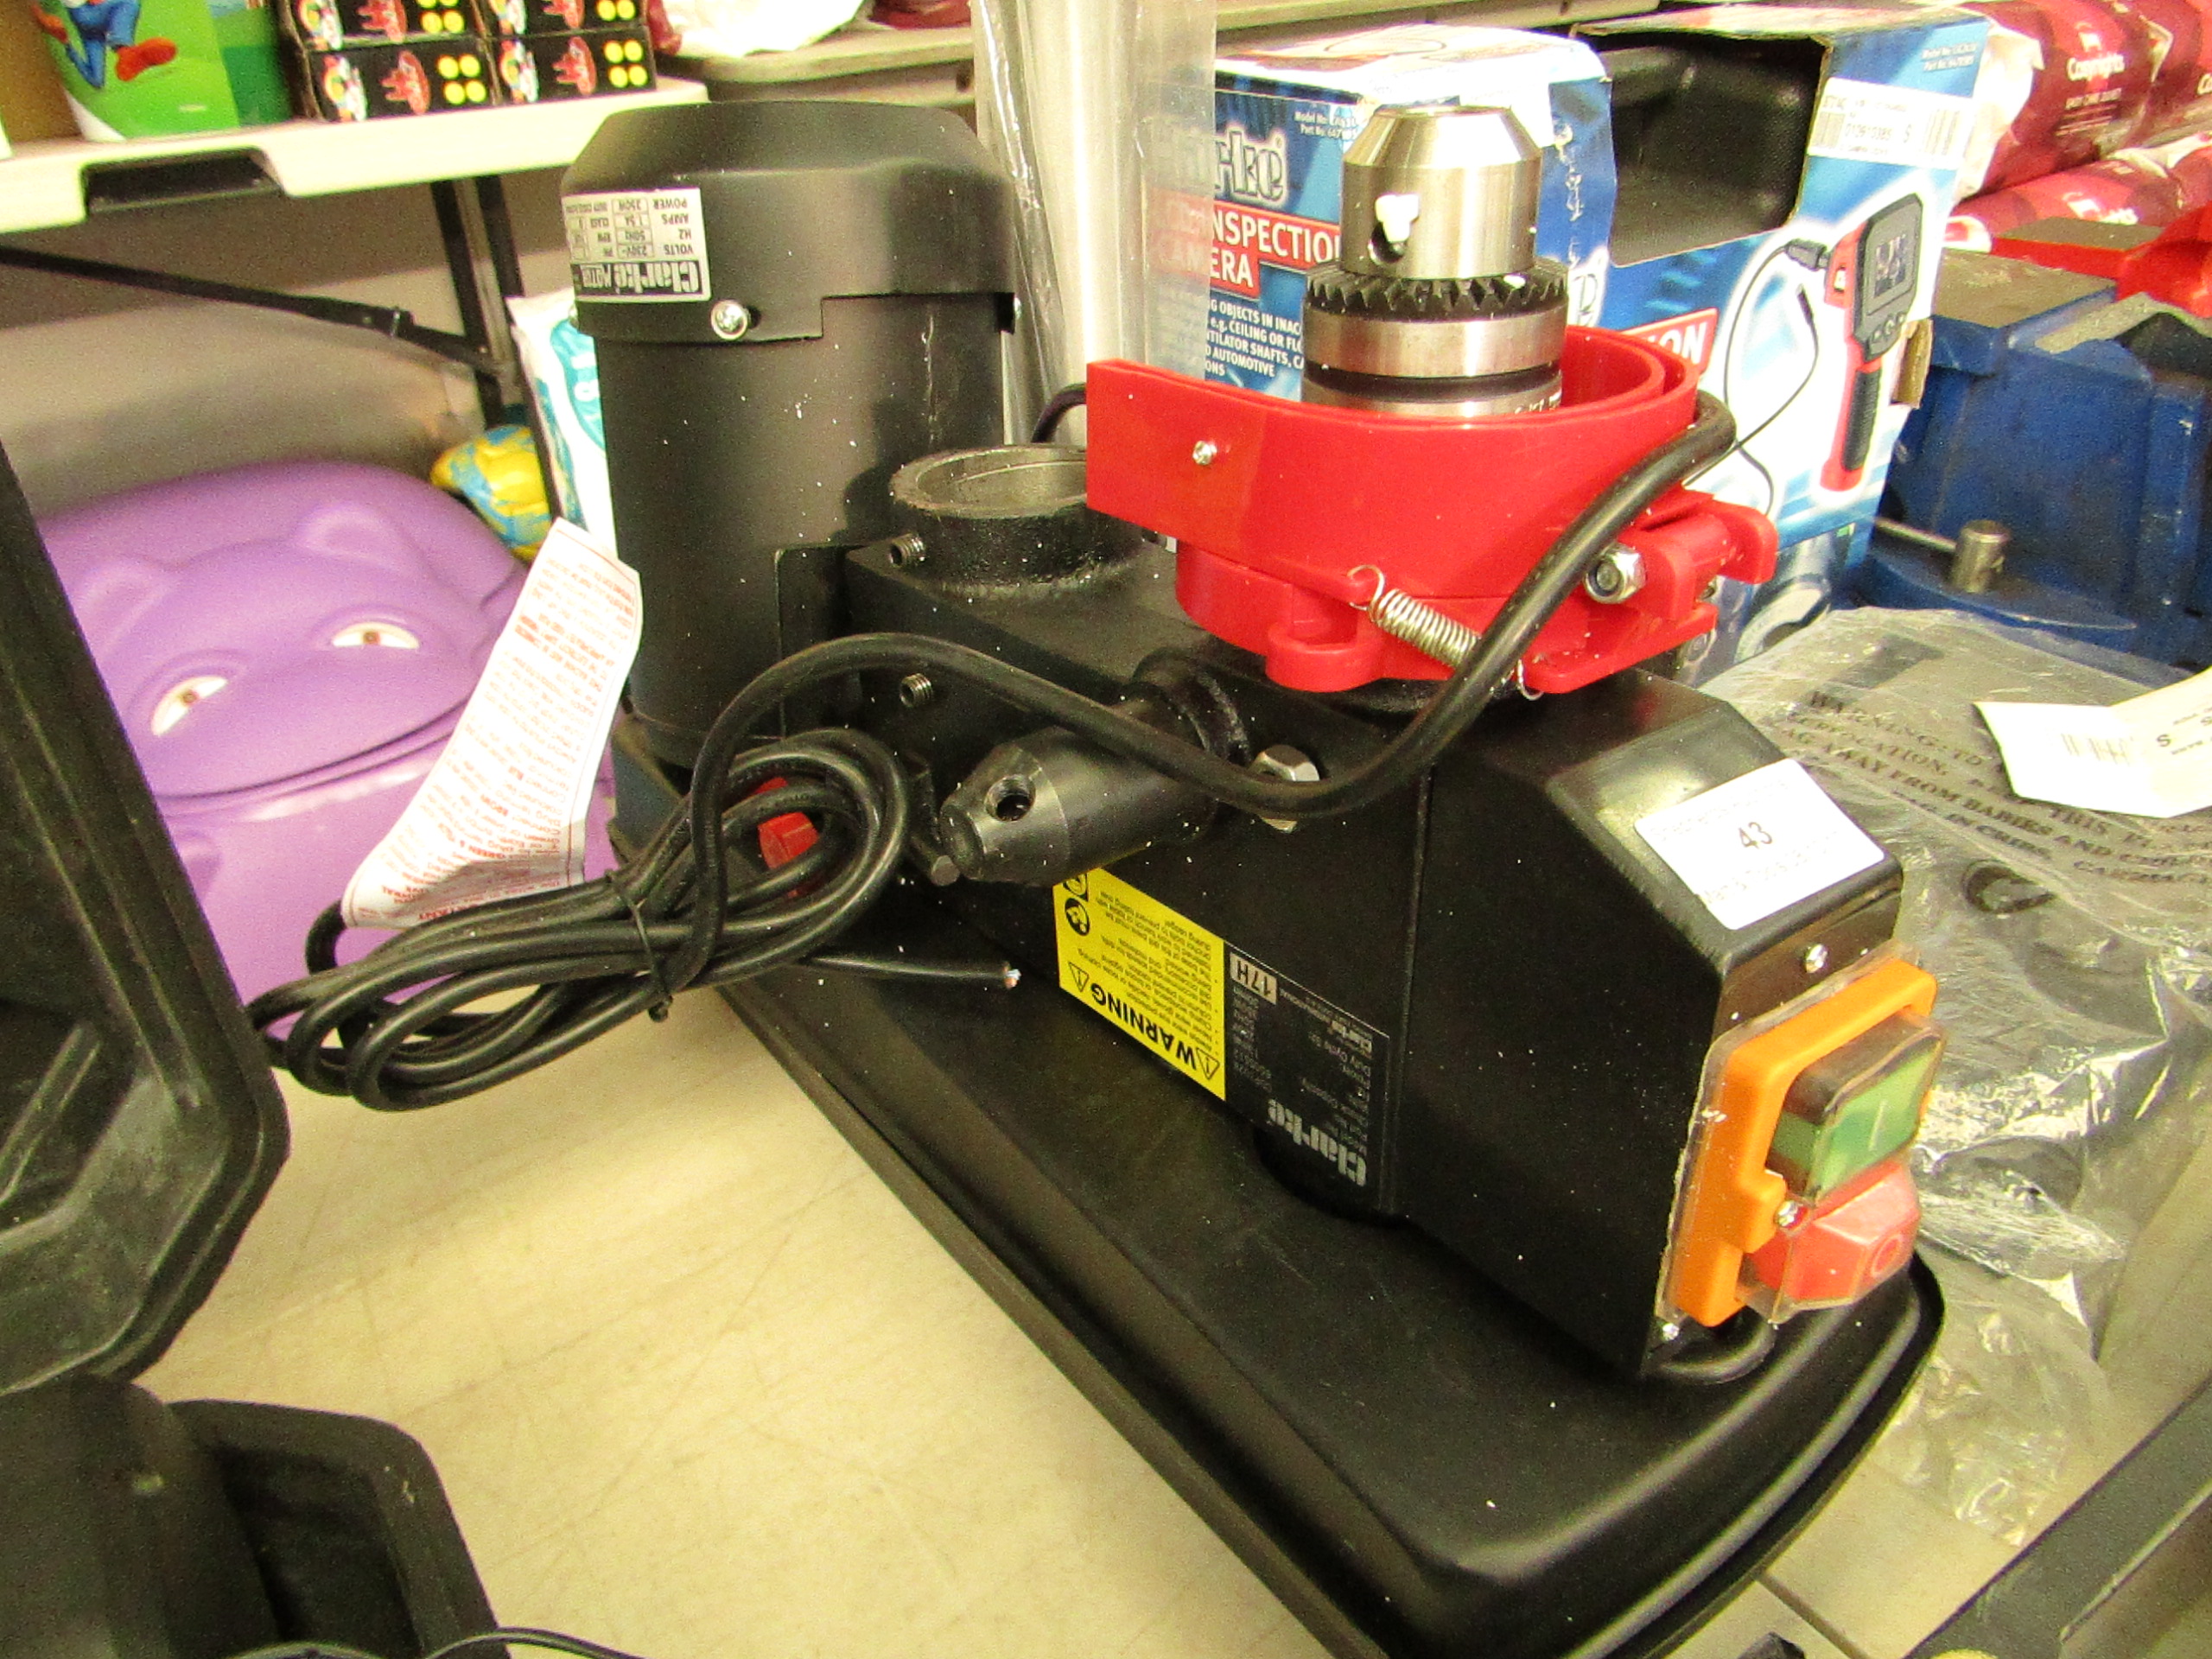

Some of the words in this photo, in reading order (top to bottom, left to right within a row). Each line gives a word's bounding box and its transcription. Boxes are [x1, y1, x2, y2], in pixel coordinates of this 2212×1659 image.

[653, 198, 688, 210] POWER
[1212, 210, 1340, 264] NSPECTIO
[614, 262, 699, 294] Clarke
[1211, 247, 1254, 288] ERA
[1219, 301, 1260, 324] OBJECTS
[1262, 314, 1274, 327] IN
[1228, 318, 1268, 342] CEILING
[1268, 331, 1284, 346] OR
[1212, 348, 1275, 378] AUTOMOTIVE
[1738, 821, 1773, 849] 43
[1236, 958, 1271, 999] 17H
[1090, 979, 1196, 1071] WARNING
[1267, 1096, 1368, 1188] Clarke
